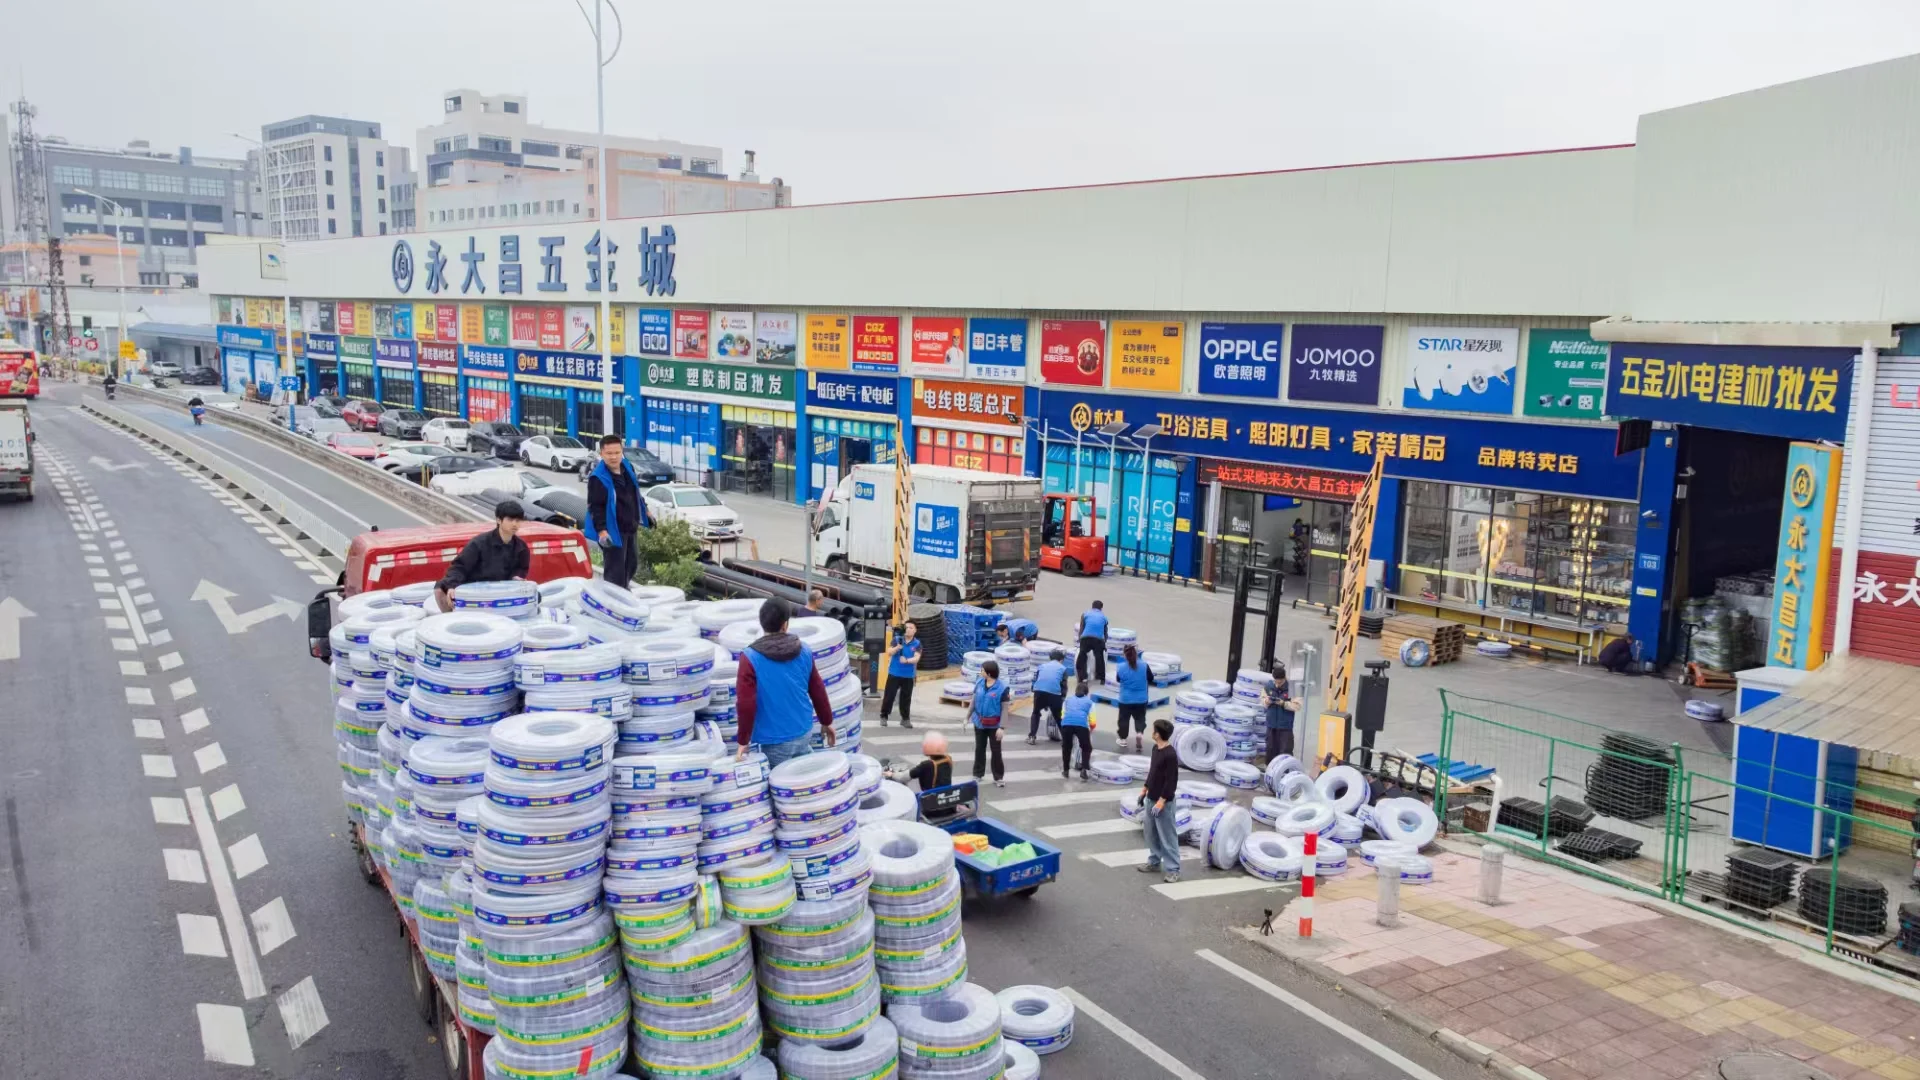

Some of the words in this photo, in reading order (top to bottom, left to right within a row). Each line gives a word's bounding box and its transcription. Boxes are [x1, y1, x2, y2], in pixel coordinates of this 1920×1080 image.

[425, 224, 677, 297] 永大昌五金城
[865, 322, 885, 333] CGZ
[986, 333, 1023, 352] 日丰管
[1203, 339, 1278, 362] OPPLE
[1418, 338, 1462, 352] STAR
[1463, 338, 1504, 353] 星发现
[1549, 341, 1599, 355] Nedfon
[1296, 347, 1375, 367] JOMOO
[1553, 360, 1585, 369] 专业品质
[686, 367, 783, 396] 塑胶制品批发
[1213, 363, 1266, 382] 欧普照明
[1309, 368, 1358, 383] 九牧精选
[1619, 356, 1839, 414] 五金水电建材批发
[923, 388, 1017, 416] 电线电缆总汇
[1477, 446, 1579, 475] 品牌特卖店
[1205, 464, 1366, 497] 一站式采购来永大昌五金城
[1774, 514, 1810, 666] 永大昌五
